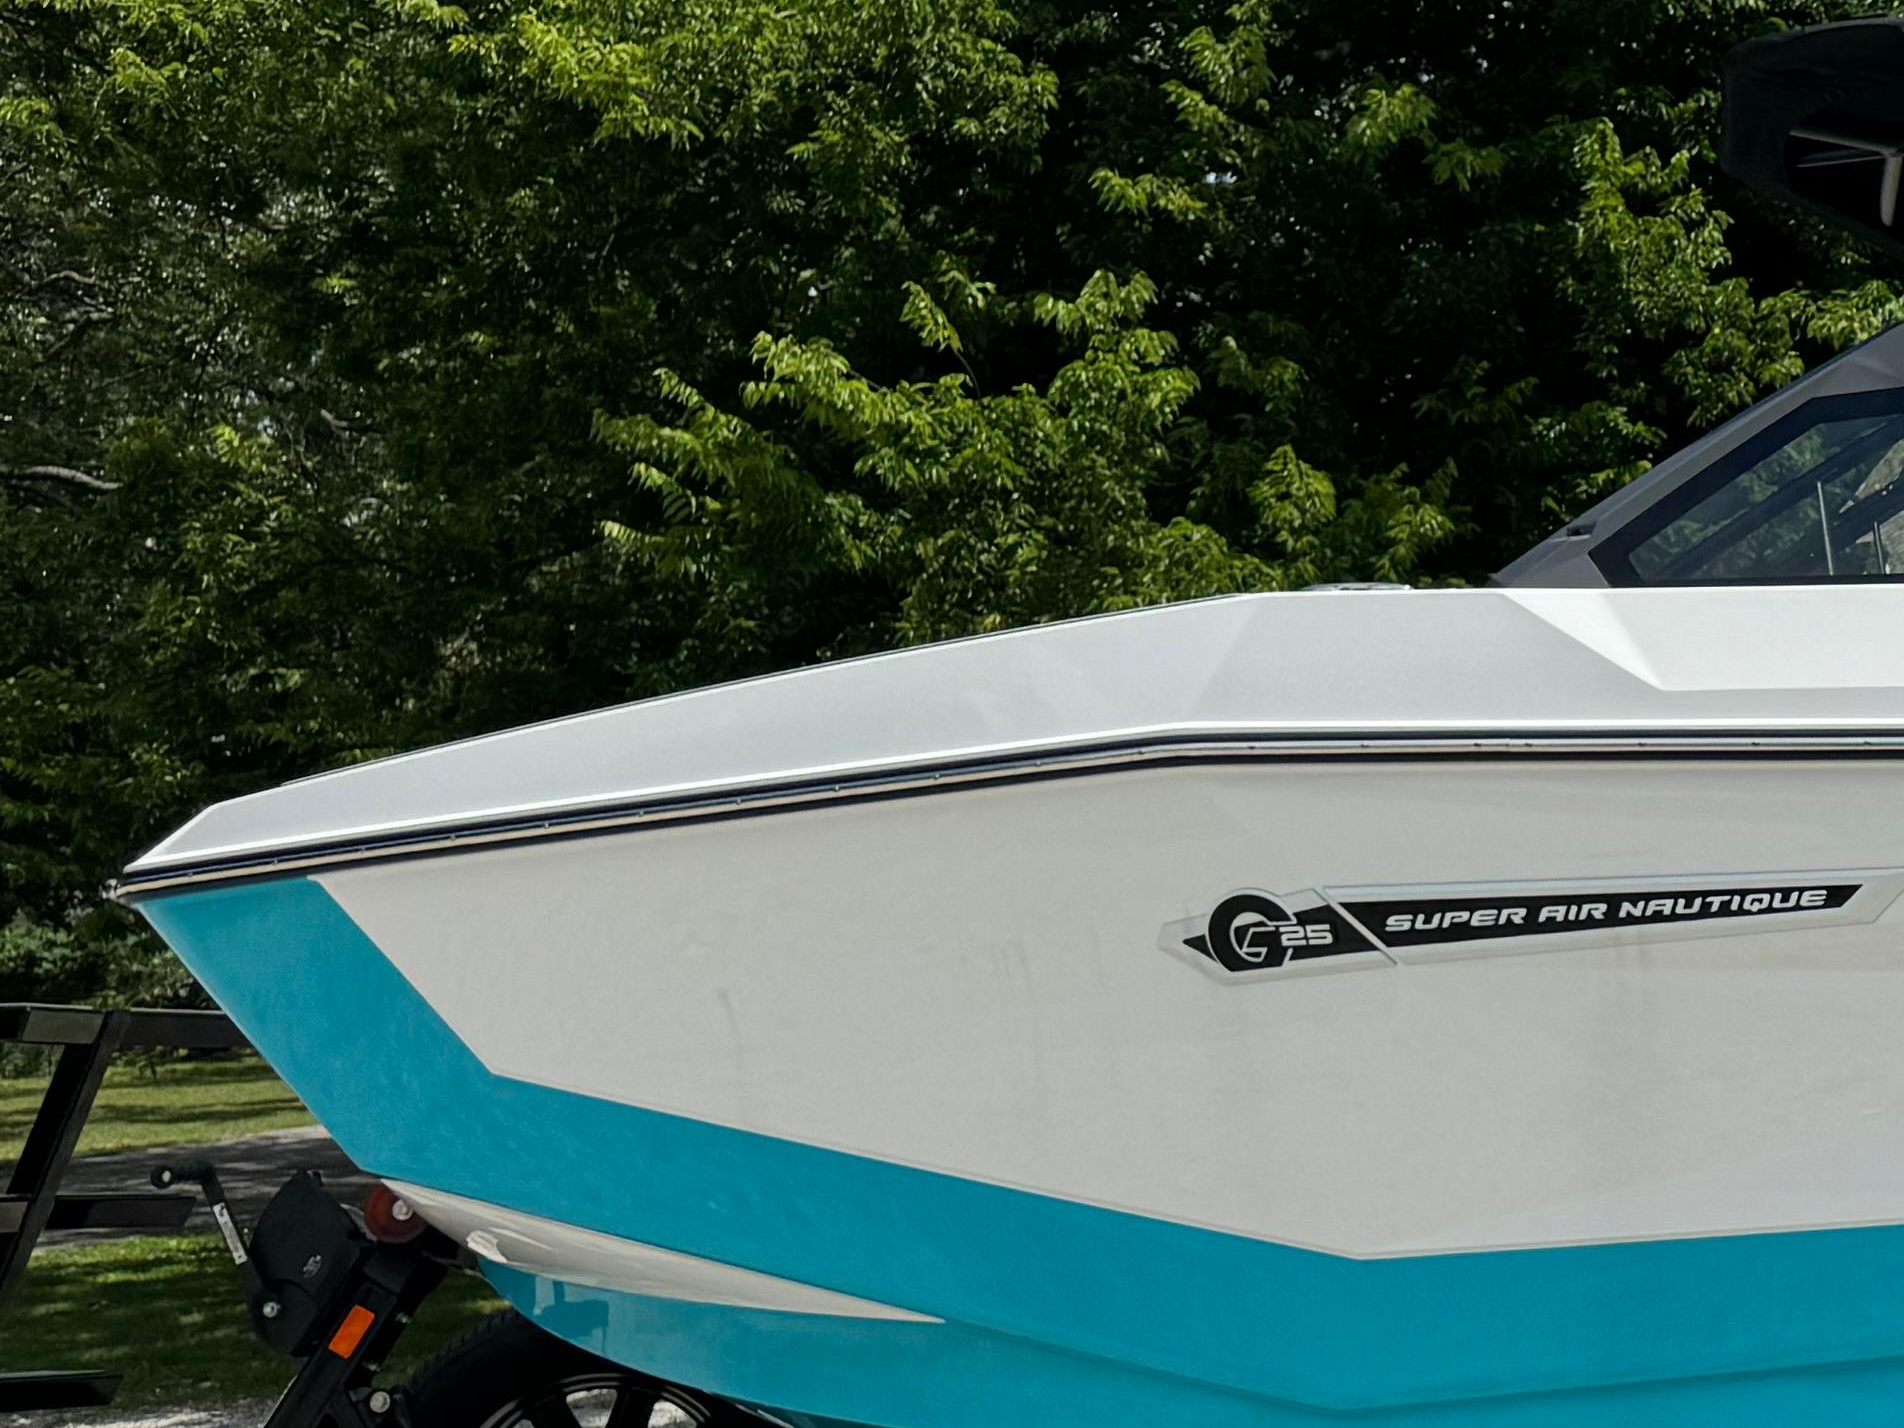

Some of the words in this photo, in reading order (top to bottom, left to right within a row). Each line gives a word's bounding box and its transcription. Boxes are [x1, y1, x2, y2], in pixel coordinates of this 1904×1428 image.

[1385, 907, 1528, 932] SUPER
[1537, 902, 1608, 923] AIR
[1618, 889, 1828, 919] NAUTIQUE
